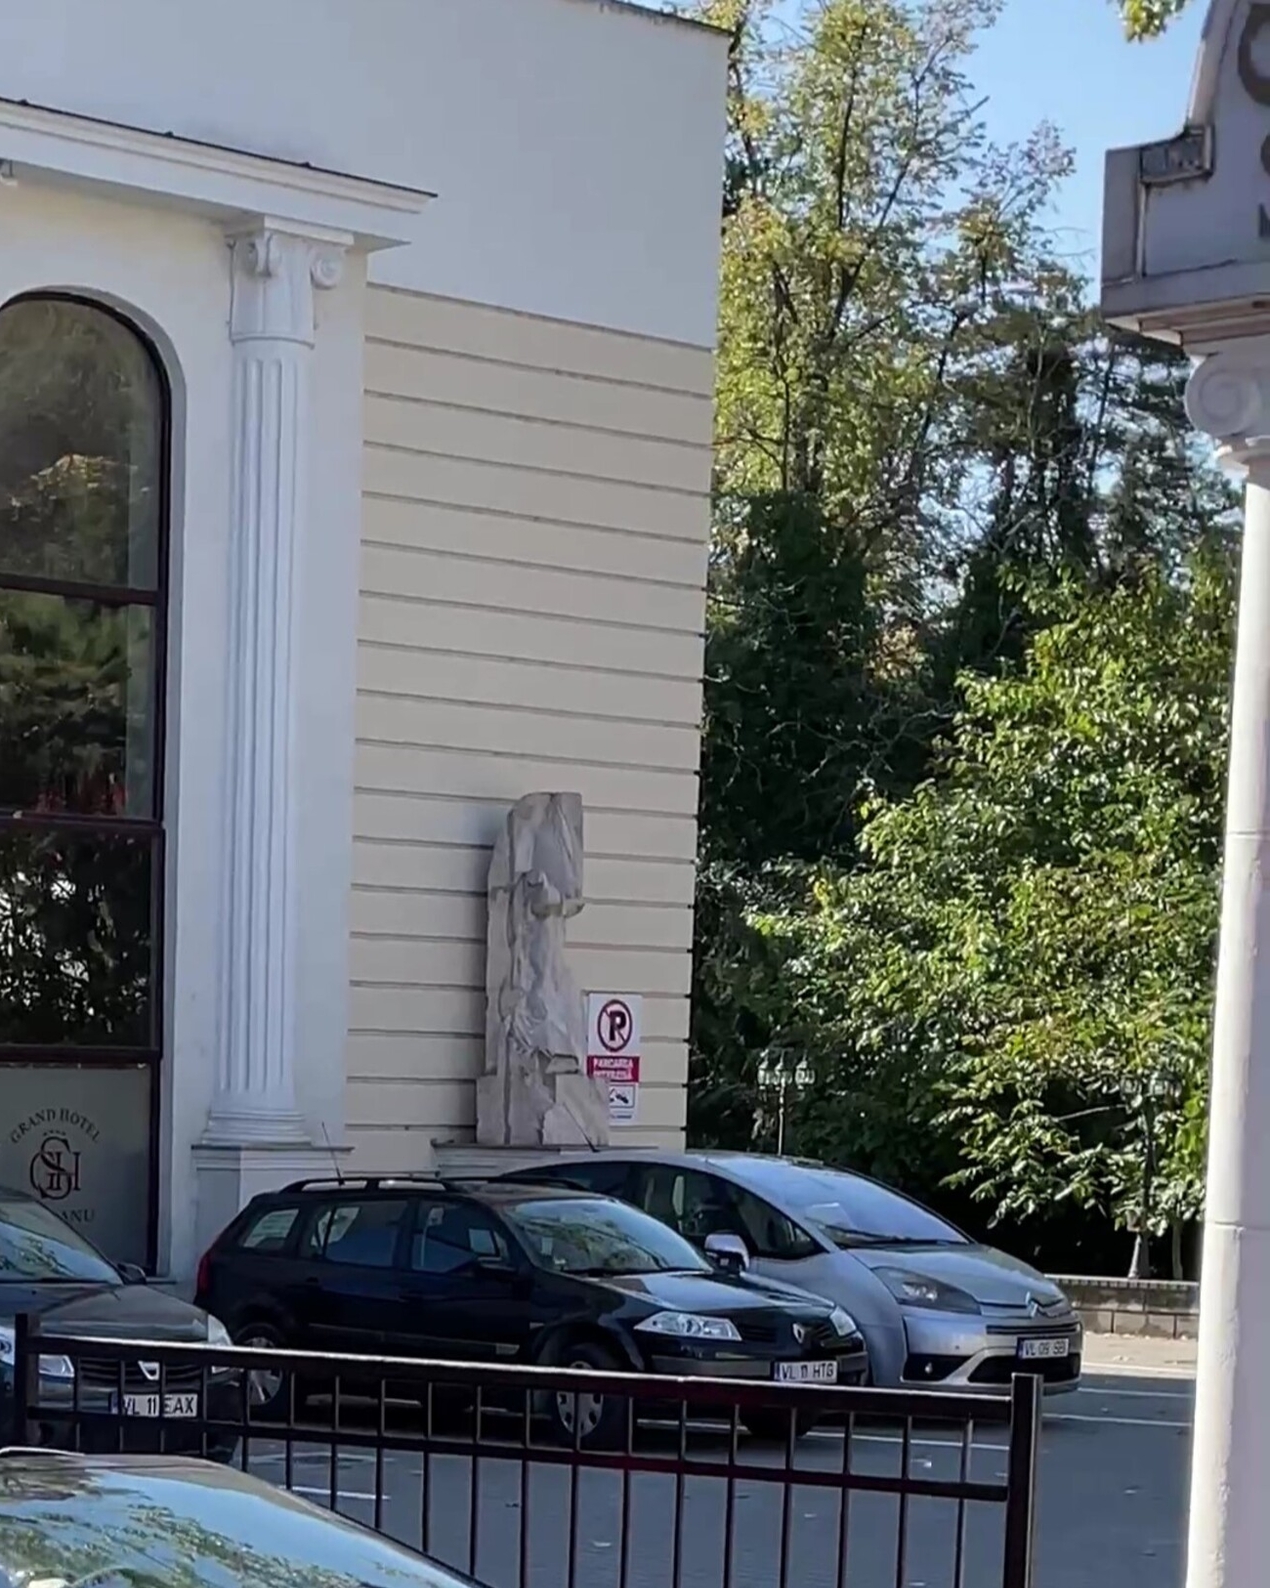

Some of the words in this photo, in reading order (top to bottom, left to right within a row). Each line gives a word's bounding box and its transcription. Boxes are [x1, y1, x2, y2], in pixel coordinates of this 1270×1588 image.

[10, 1108, 56, 1144] GRAND
[59, 1107, 101, 1143] HOTEL
[781, 1364, 796, 1380] VL
[122, 1397, 140, 1415] VL
[147, 1396, 157, 1415] 11
[163, 1396, 195, 1415] EAX
